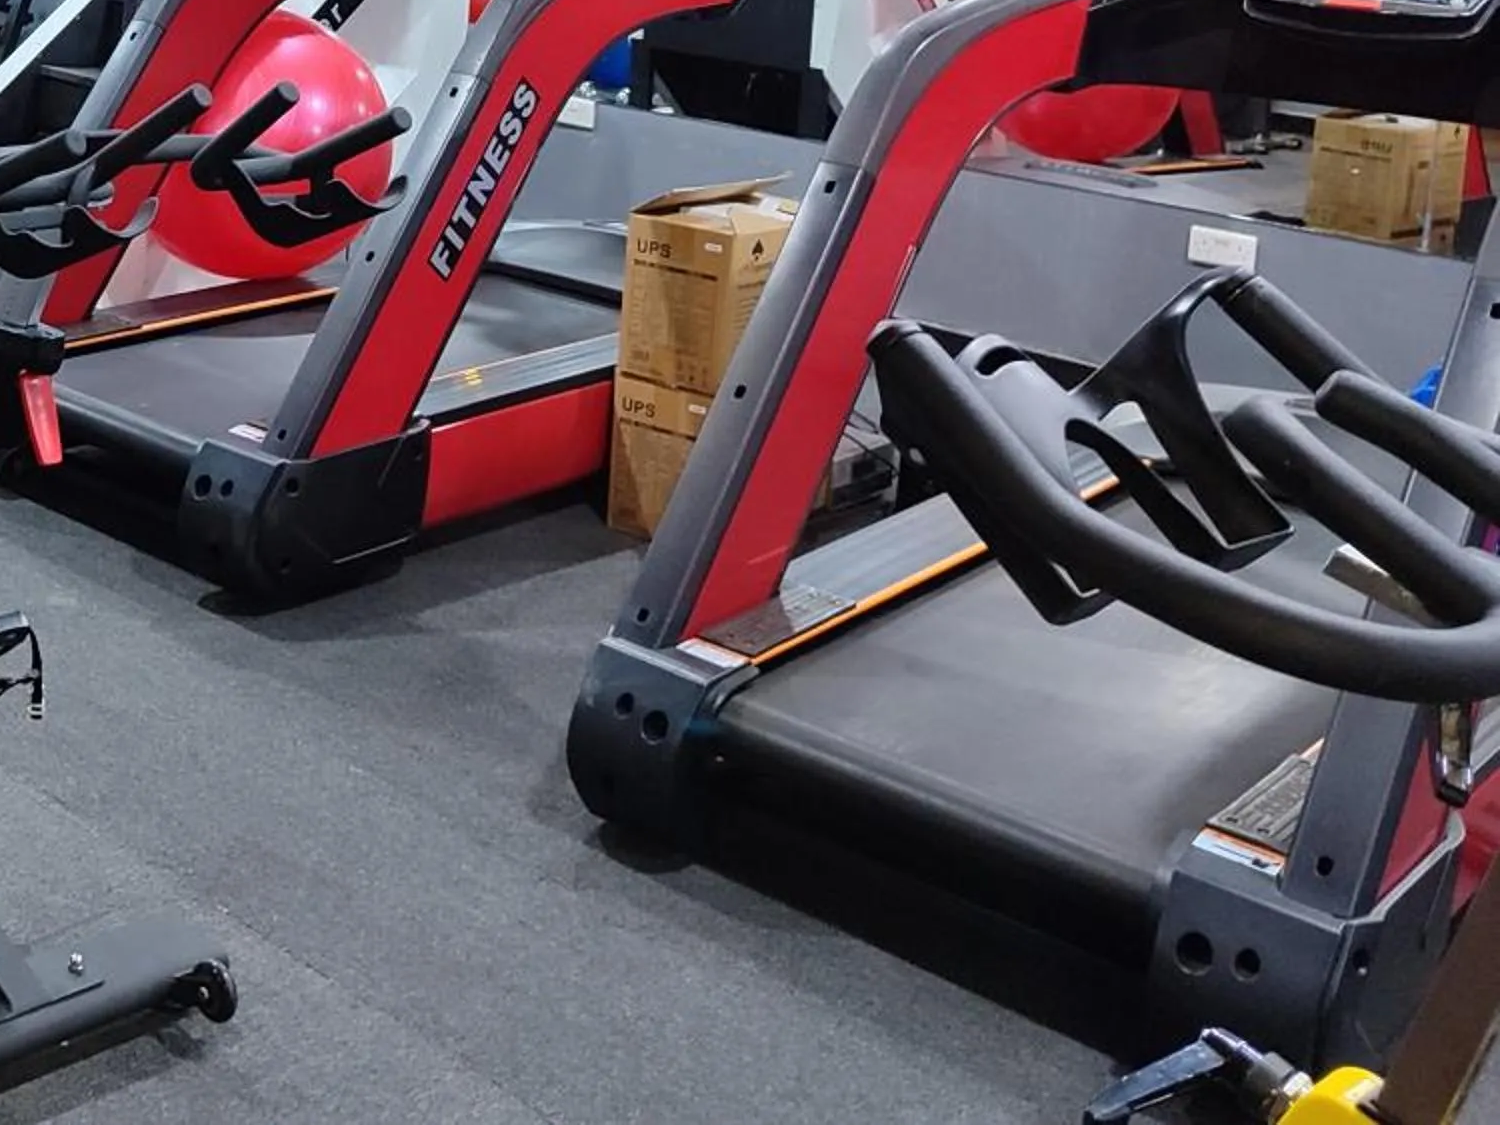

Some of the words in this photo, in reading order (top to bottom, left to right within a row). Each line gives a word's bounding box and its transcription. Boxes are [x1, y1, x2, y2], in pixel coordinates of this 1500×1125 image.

[429, 83, 537, 279] FITNESS
[637, 238, 672, 259] UPS
[621, 396, 656, 418] UPS
